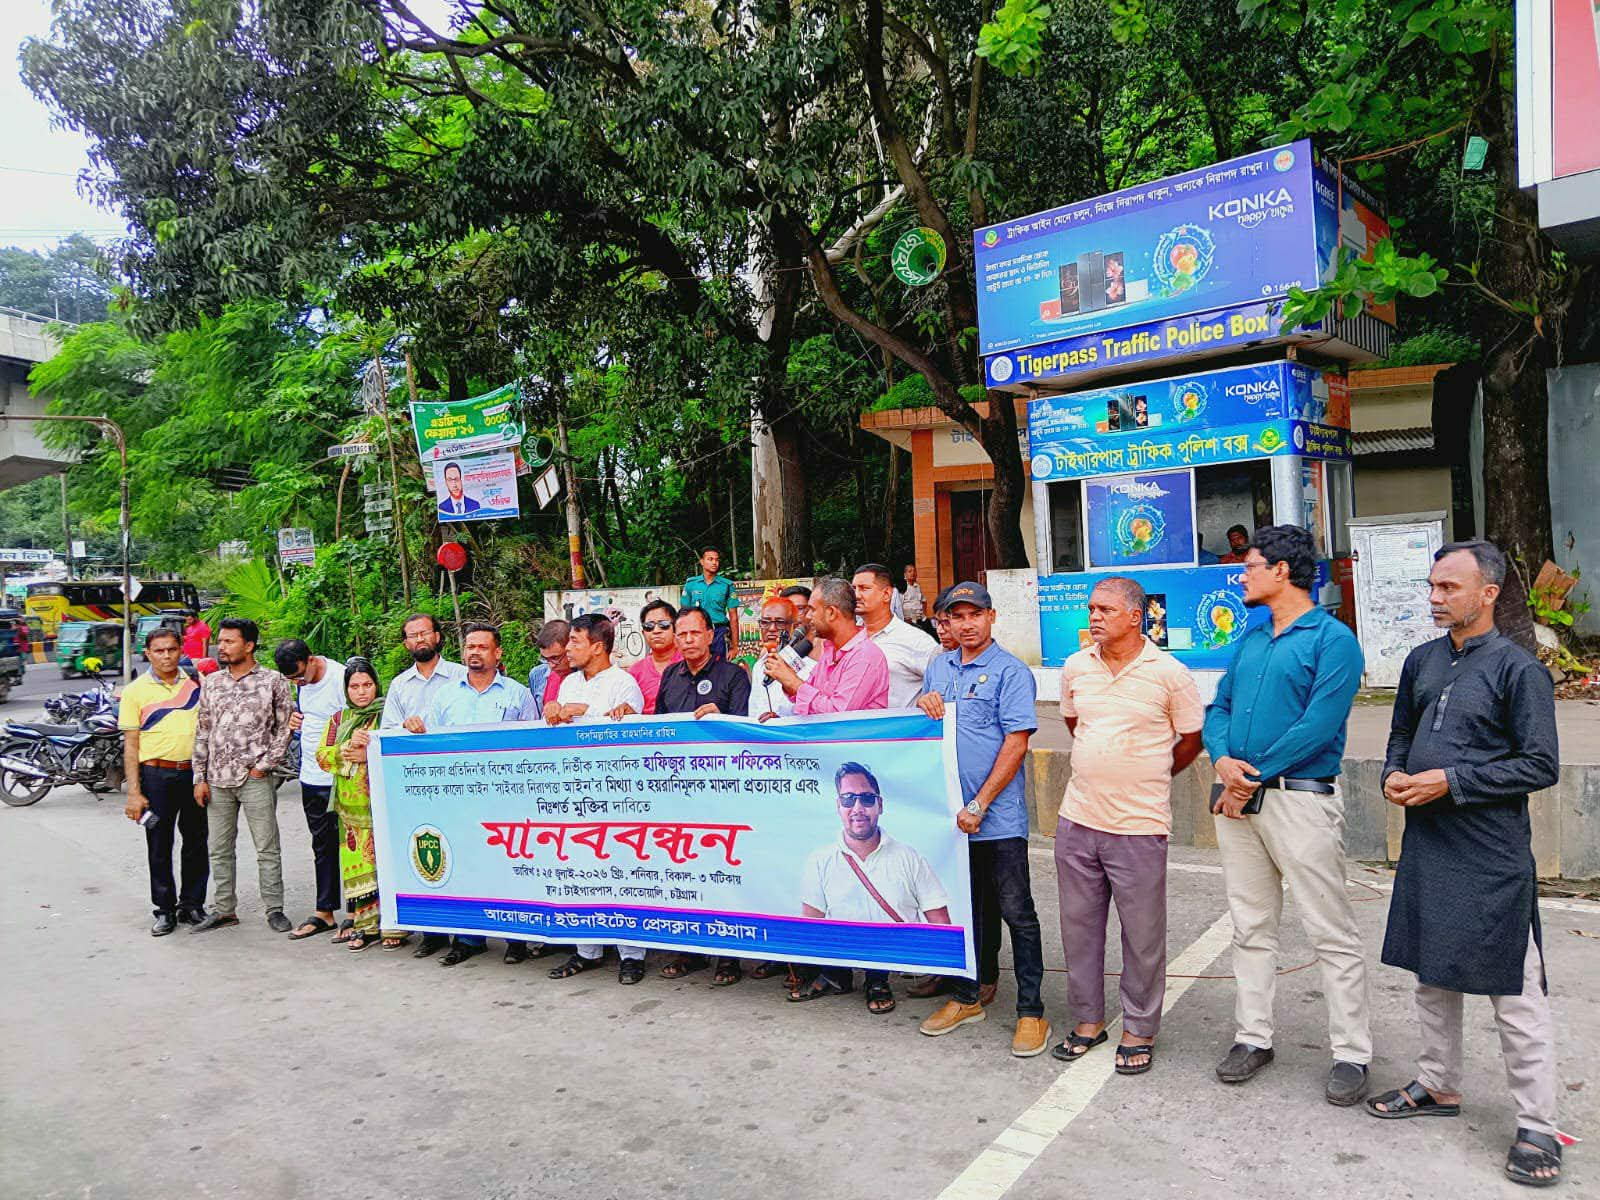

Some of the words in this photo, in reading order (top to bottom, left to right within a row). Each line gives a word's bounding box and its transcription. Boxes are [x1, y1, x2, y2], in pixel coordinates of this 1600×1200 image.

[1007, 222, 1030, 239] ট্রাফিক
[1031, 217, 1051, 232] আইন
[1054, 213, 1071, 225] মেনে
[1095, 202, 1114, 215] নিজে
[1116, 195, 1145, 210] নিরাপদ
[1174, 177, 1204, 193] অন্যকে
[1206, 168, 1237, 185] নিরাপদ
[1208, 187, 1293, 221] KONKA
[1237, 209, 1269, 226] happy
[1017, 347, 1098, 377] Tigerpass
[1102, 331, 1160, 359] Traffic
[1166, 321, 1224, 349] Police
[1230, 314, 1269, 337] Box
[1225, 380, 1280, 397] KONKA
[1055, 448, 1125, 472] টাইগারপাস
[1127, 440, 1173, 468] ট্রাফিক
[1178, 434, 1217, 463] পুলিশ
[1222, 434, 1249, 456] বক্স
[1111, 481, 1160, 495] KONKA
[576, 729, 619, 742] বিসমিল্লাহির
[621, 728, 653, 739] রাহমানির
[655, 726, 676, 738] রাহিম
[404, 762, 427, 778] দৈনিক
[429, 765, 446, 777] ঢাকা
[488, 760, 513, 776] বিশেষ
[562, 756, 592, 775] নির্ভীক
[596, 755, 640, 773] সাংবাদিক
[642, 751, 686, 774] হাফিজুর
[689, 755, 726, 771] রহমান
[731, 750, 782, 771] শফিকের
[784, 753, 820, 771] বিরুদ্ধে
[443, 783, 464, 796] কালো
[466, 781, 489, 796] আইন
[527, 778, 561, 796] নিরাপত্তা
[605, 776, 632, 793] মিথ্যা
[636, 780, 645, 792] ও
[709, 778, 741, 793] মামলা
[744, 777, 791, 794] প্রত্যাহার
[795, 778, 821, 795] এবং
[536, 796, 570, 815] নিঃশর্ত
[573, 796, 609, 818] মুক্তির
[612, 796, 652, 814] দাবিতে
[419, 839, 439, 850] UPCC
[481, 818, 753, 866] মানববন্ধন
[543, 868, 553, 878] ২৫
[699, 874, 707, 883] ৩
[710, 871, 742, 885] ঘটিকায়
[554, 911, 638, 929] ইউনাইটেড
[642, 916, 701, 935] প্রেসক্লাব
